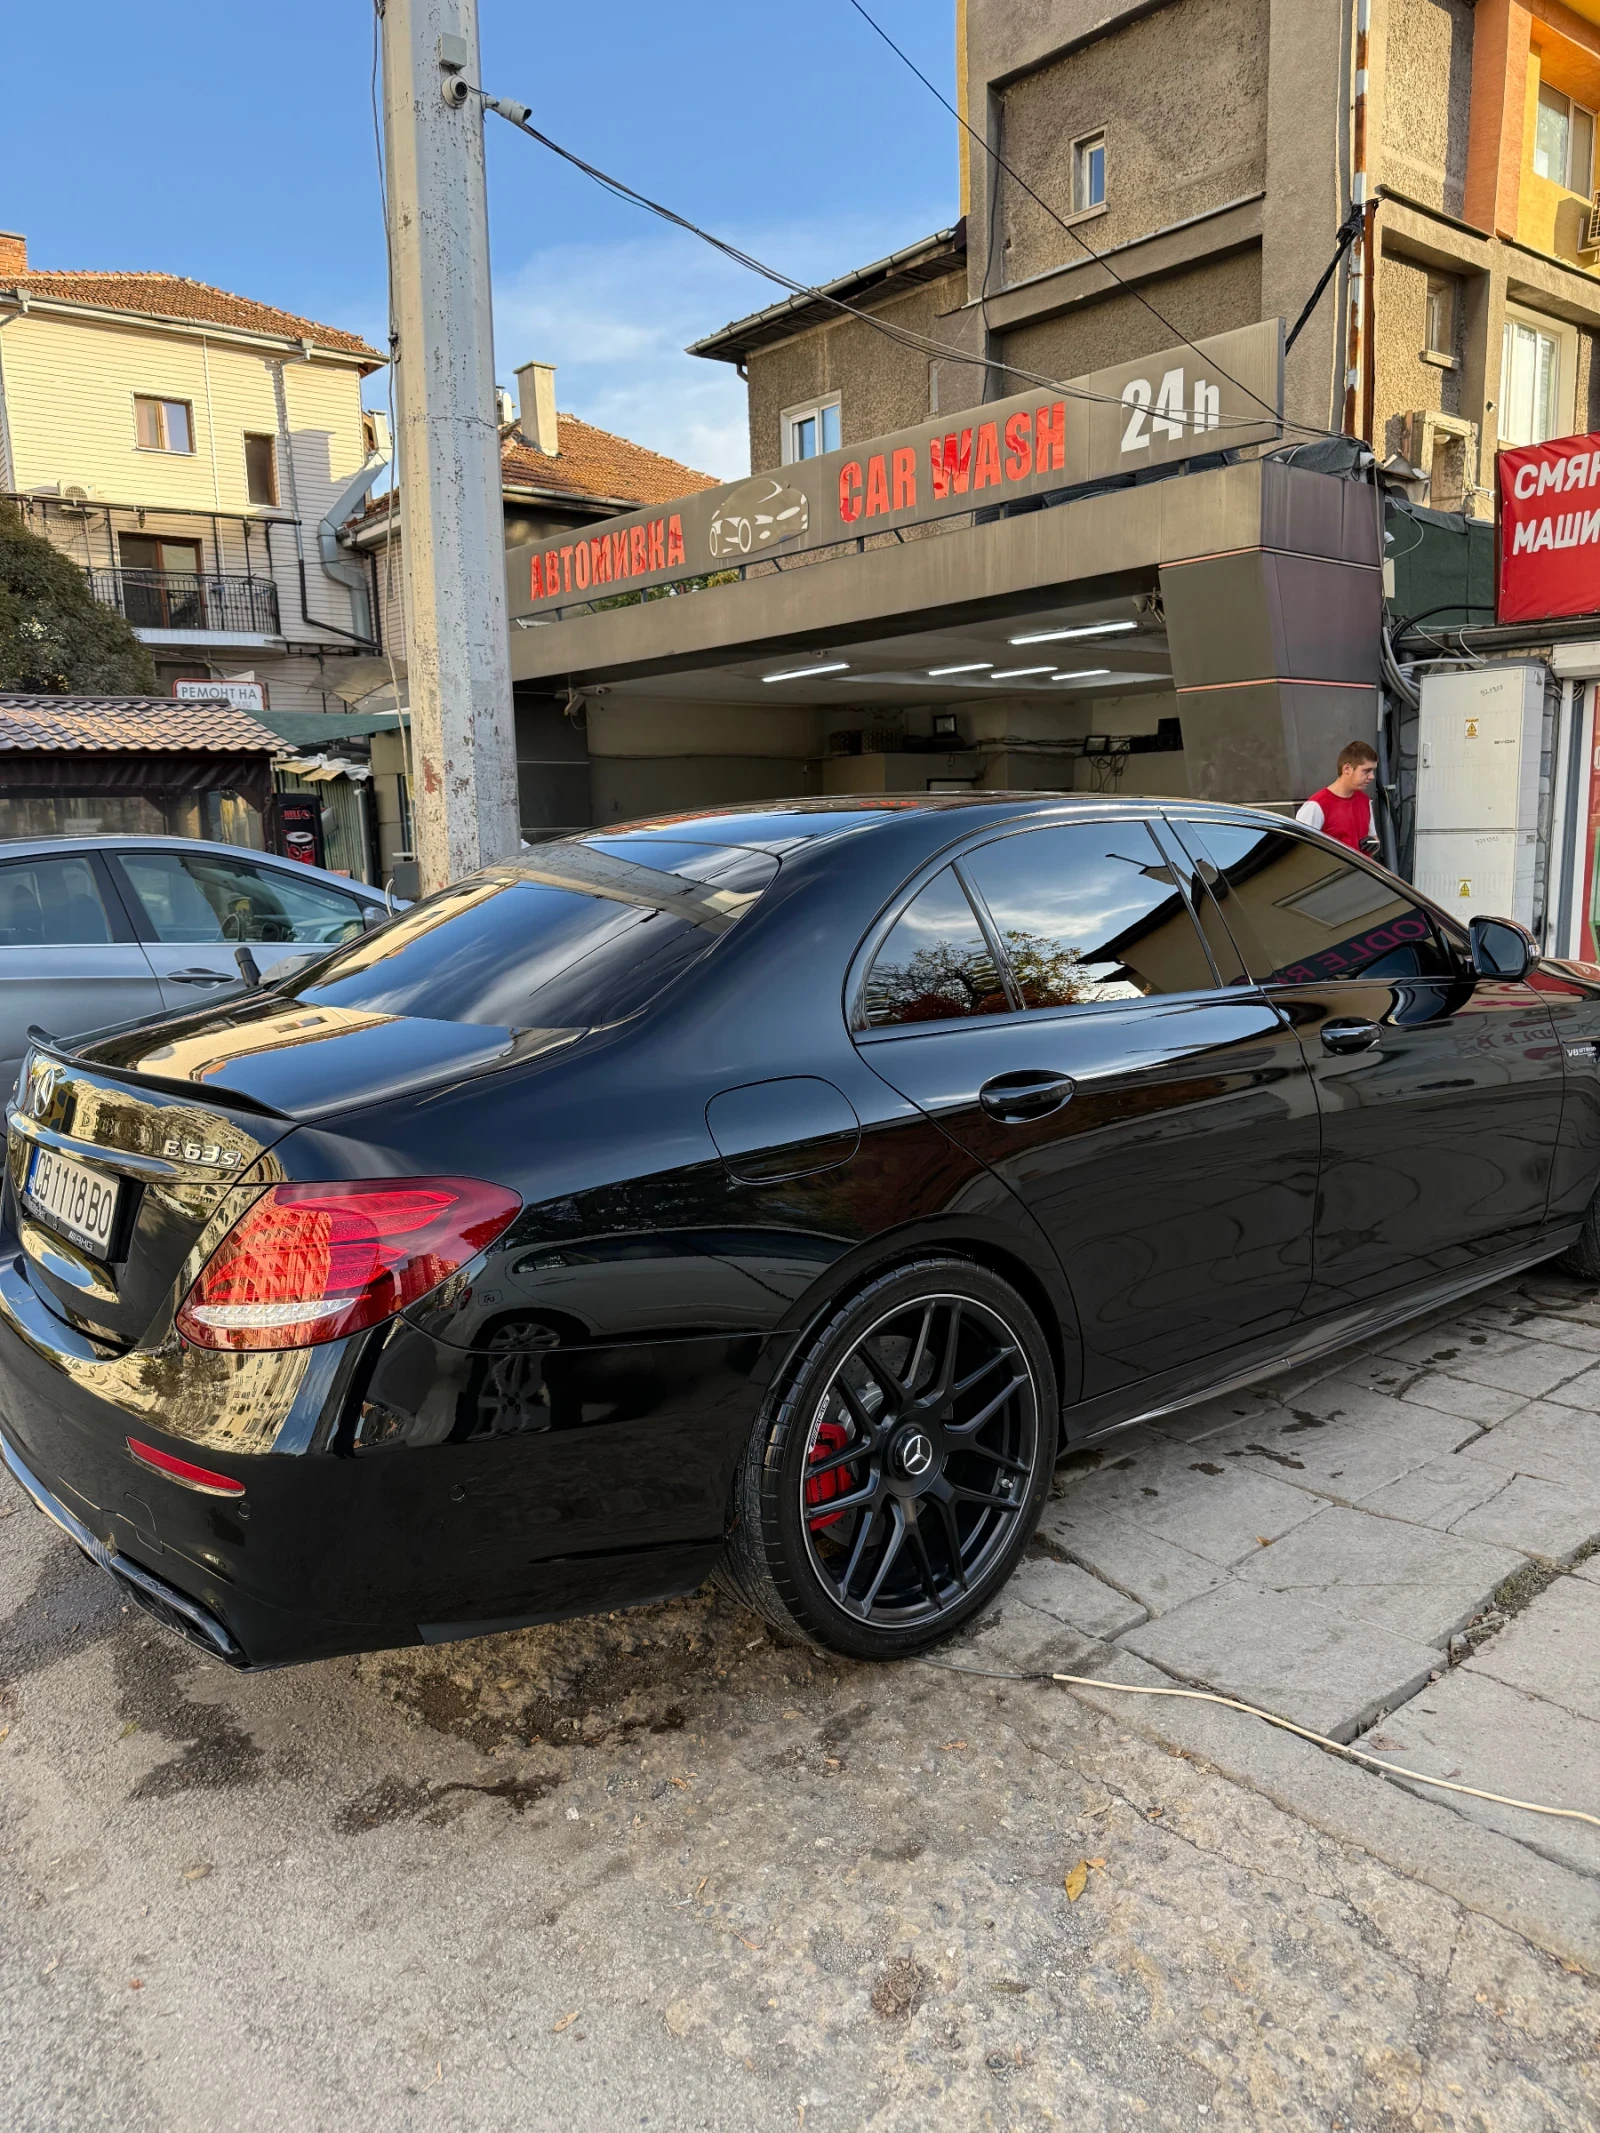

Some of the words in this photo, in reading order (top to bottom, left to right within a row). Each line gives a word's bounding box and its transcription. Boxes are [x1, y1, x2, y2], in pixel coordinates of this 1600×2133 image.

[839, 447, 916, 524] CAR
[930, 401, 1066, 500] WASH
[530, 514, 686, 602] АВТОМИВКА
[181, 686, 235, 699] РЕМОНТ
[239, 688, 258, 700] НА
